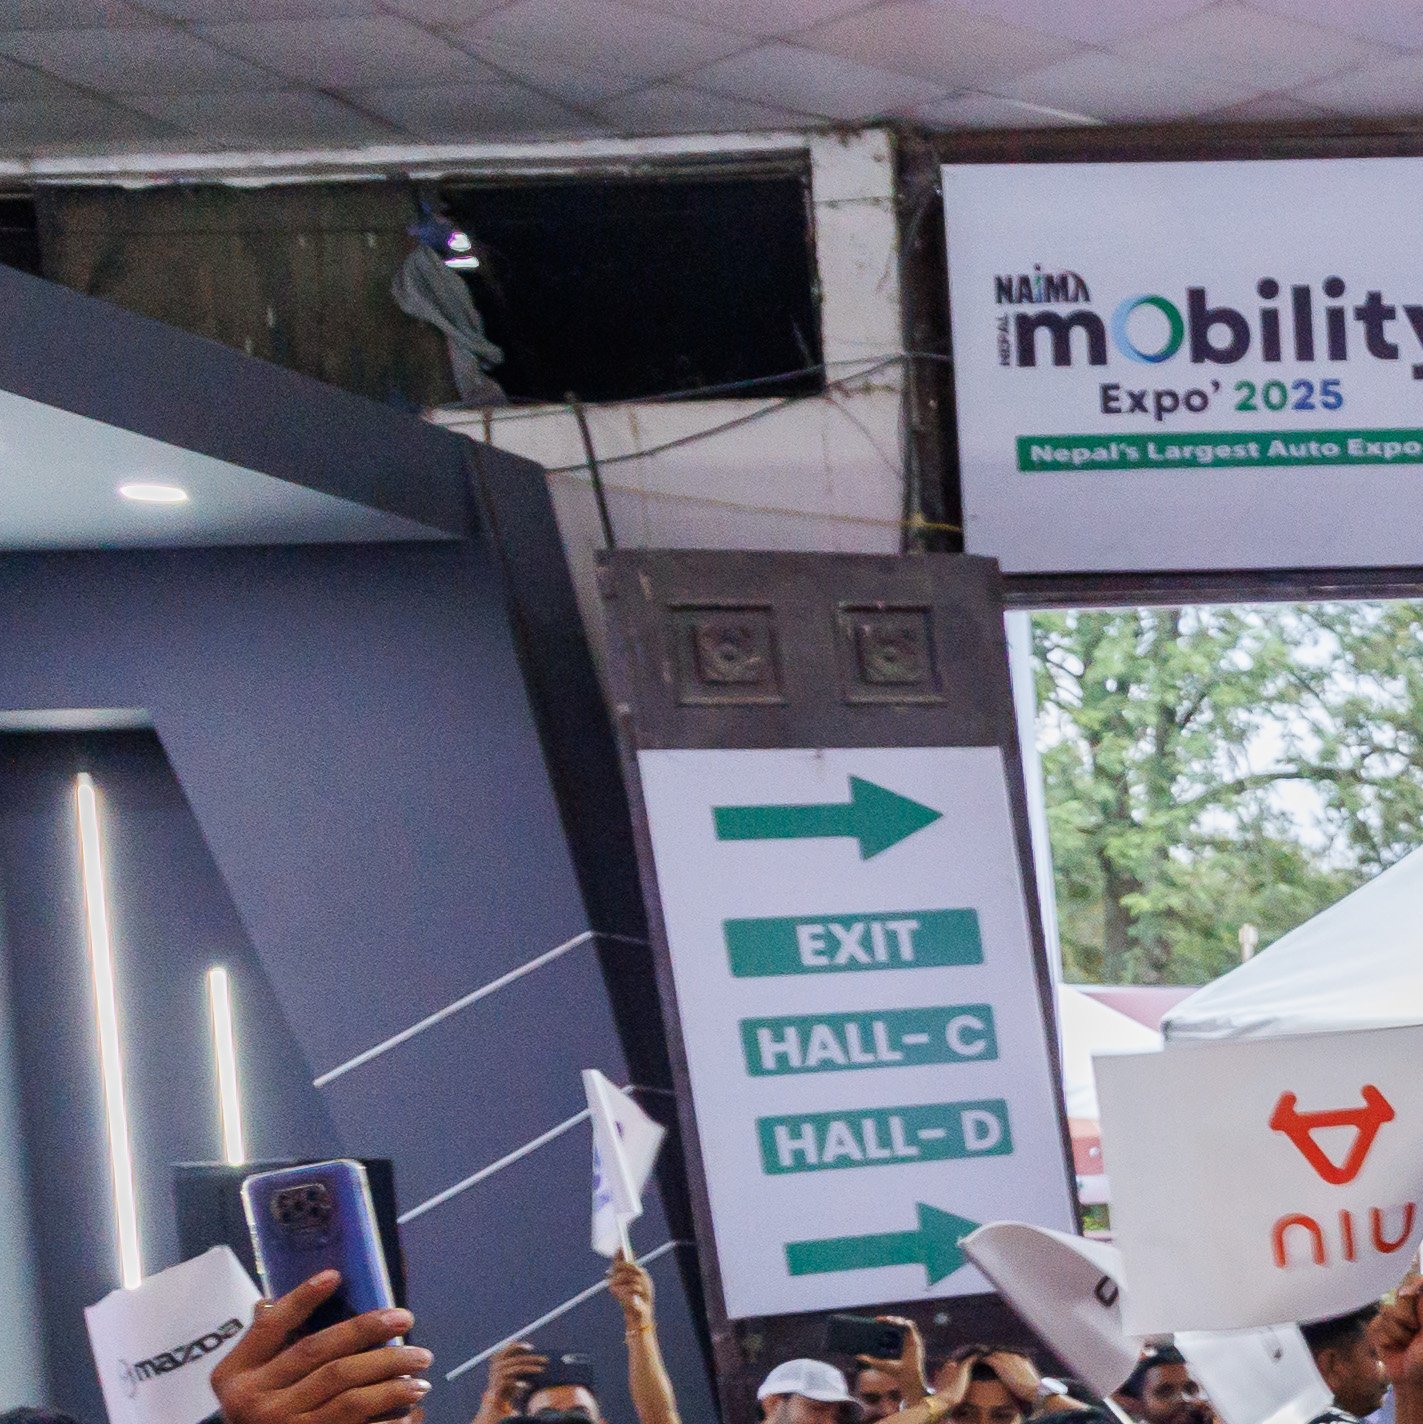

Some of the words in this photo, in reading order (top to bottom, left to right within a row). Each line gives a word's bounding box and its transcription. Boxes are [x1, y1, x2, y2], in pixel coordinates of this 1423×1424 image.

[1234, 379, 1344, 412] 2025
[1030, 442, 1140, 466] Nepal's
[1148, 439, 1261, 463] Largest
[1267, 438, 1340, 458] Auto
[1347, 437, 1423, 460] Expo
[796, 919, 921, 967] EXIT
